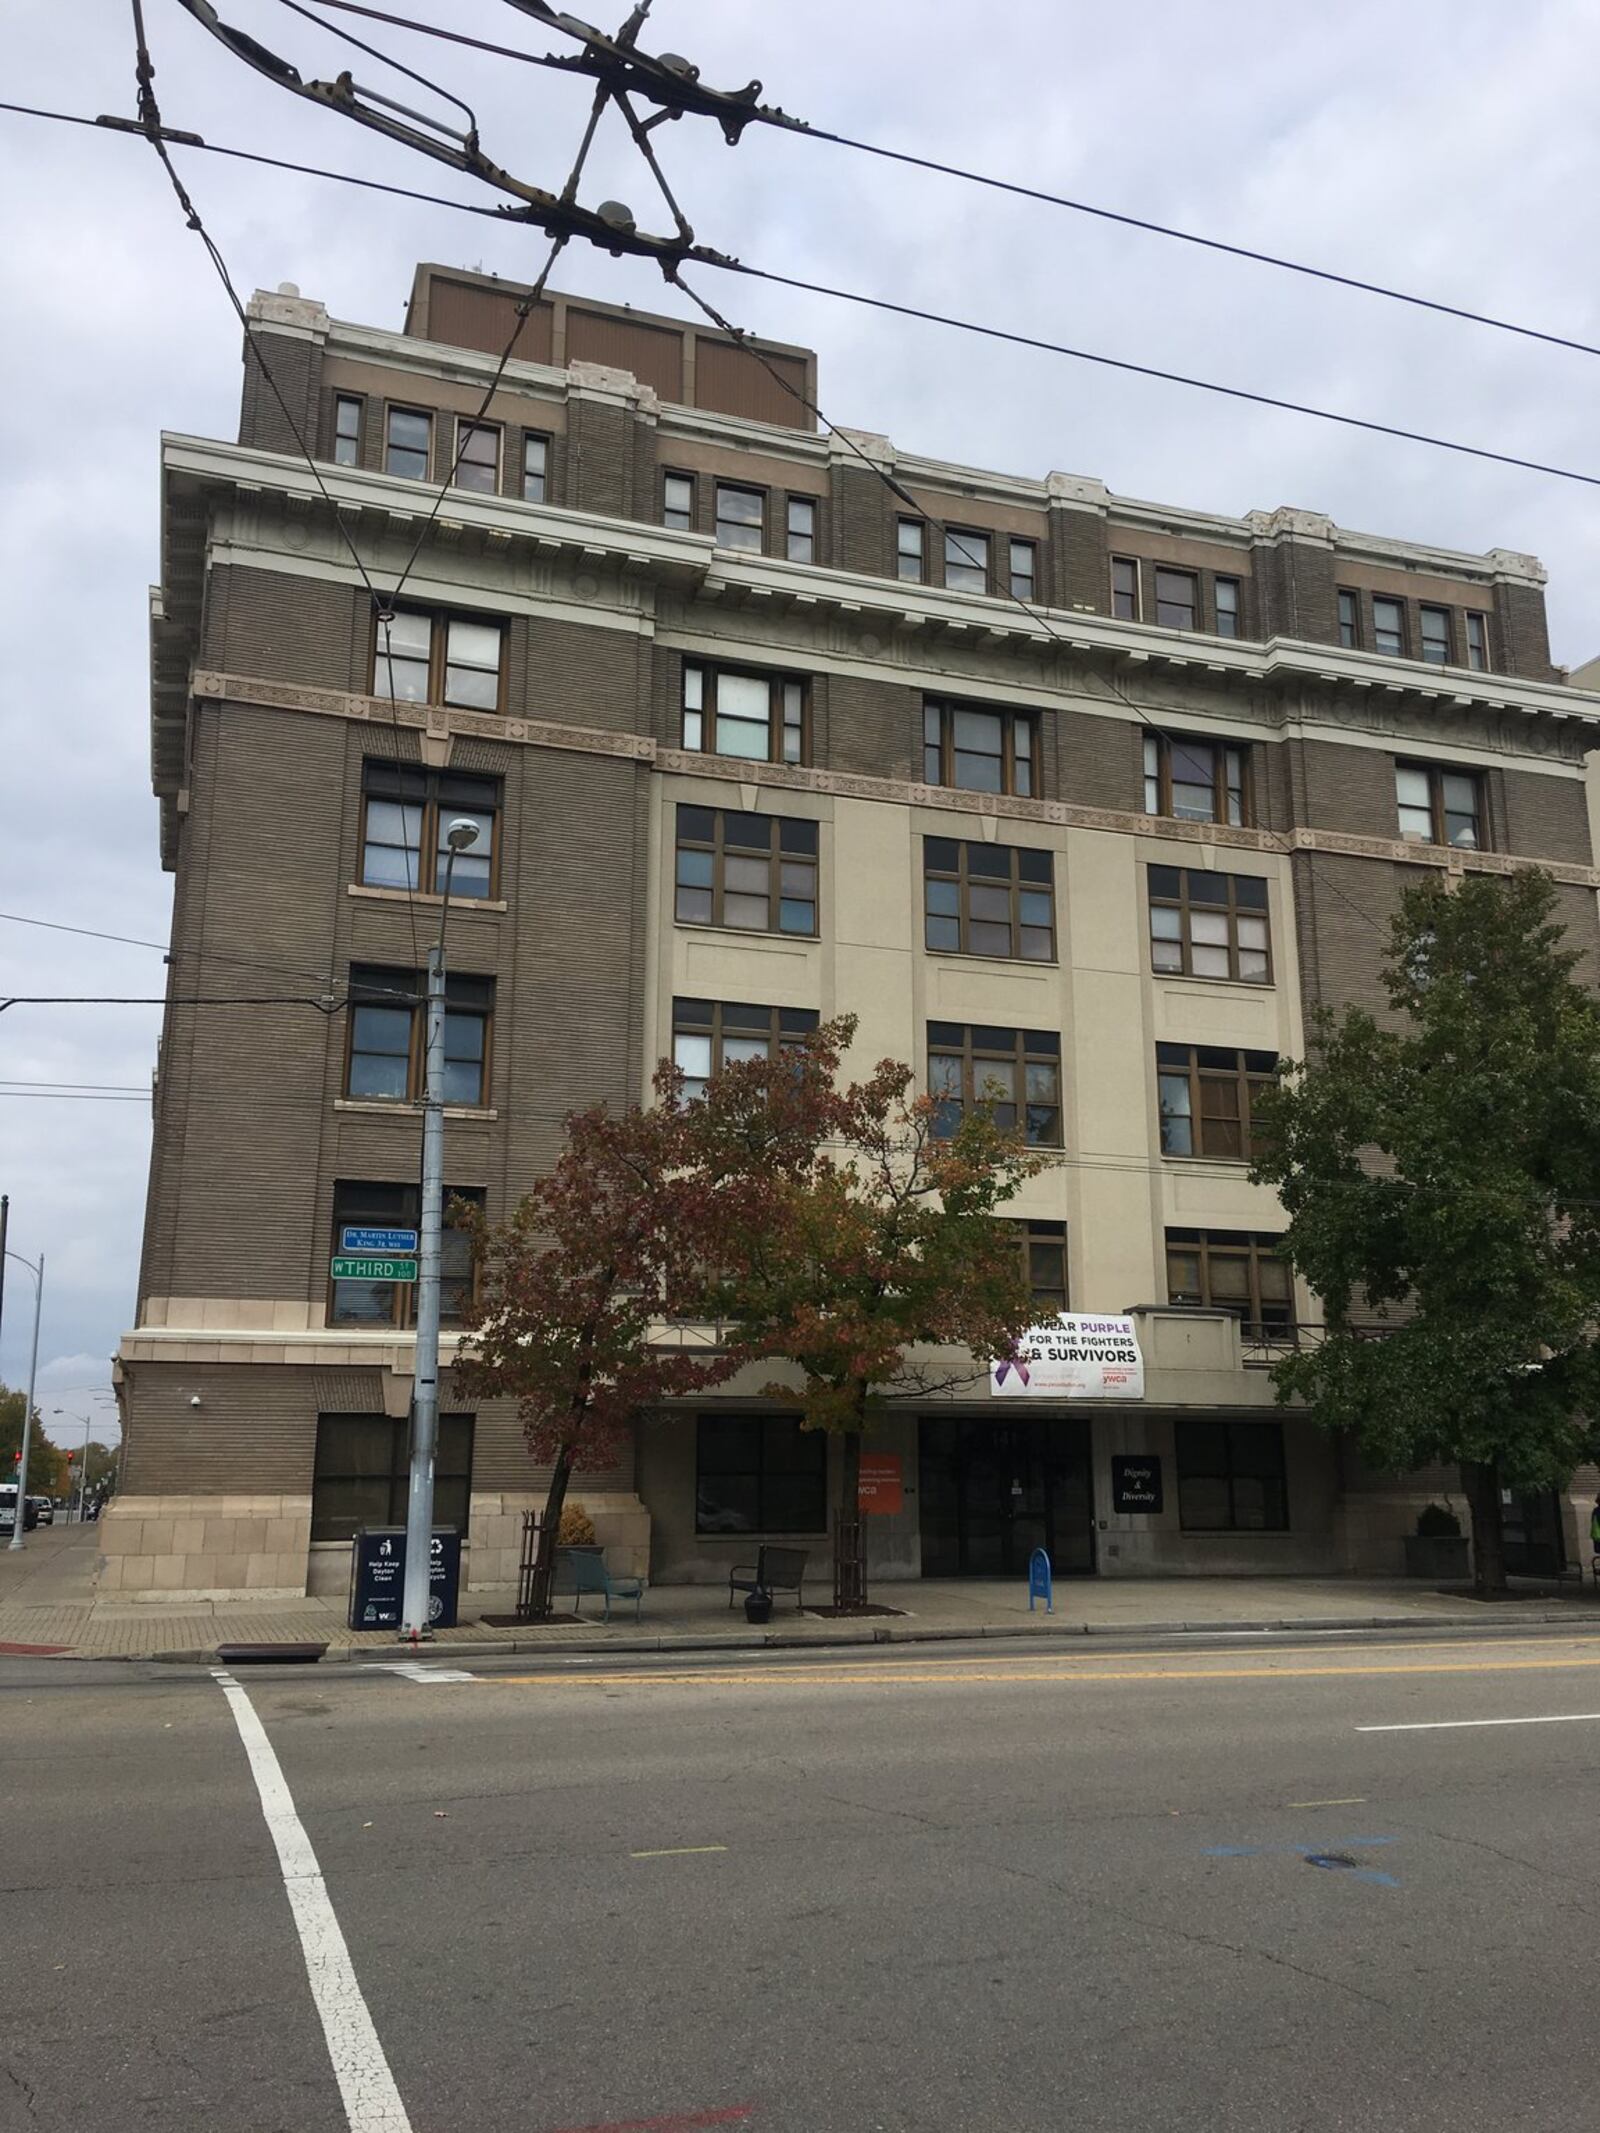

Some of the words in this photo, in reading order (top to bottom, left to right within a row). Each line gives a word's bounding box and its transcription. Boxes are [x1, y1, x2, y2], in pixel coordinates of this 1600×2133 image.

[360, 1231, 386, 1239] MARTIN
[388, 1232, 415, 1241] LUTHER
[356, 1239, 375, 1247] KING
[334, 1262, 343, 1272] W
[344, 1261, 394, 1277] THIRD
[400, 1262, 410, 1270] ST
[397, 1270, 412, 1278] 100
[1036, 1321, 1076, 1332] WEAR
[1080, 1322, 1131, 1334] PURPLE
[1029, 1335, 1052, 1344] FOR
[1056, 1336, 1078, 1345] THE
[1081, 1337, 1134, 1347] FIGHTERS
[1031, 1348, 1042, 1360] &
[1048, 1348, 1137, 1363] SURVIVORS
[1102, 1375, 1127, 1384] ywca
[1123, 1467, 1152, 1479] Dignity
[1133, 1480, 1141, 1489] &
[1121, 1490, 1156, 1504] Diversity
